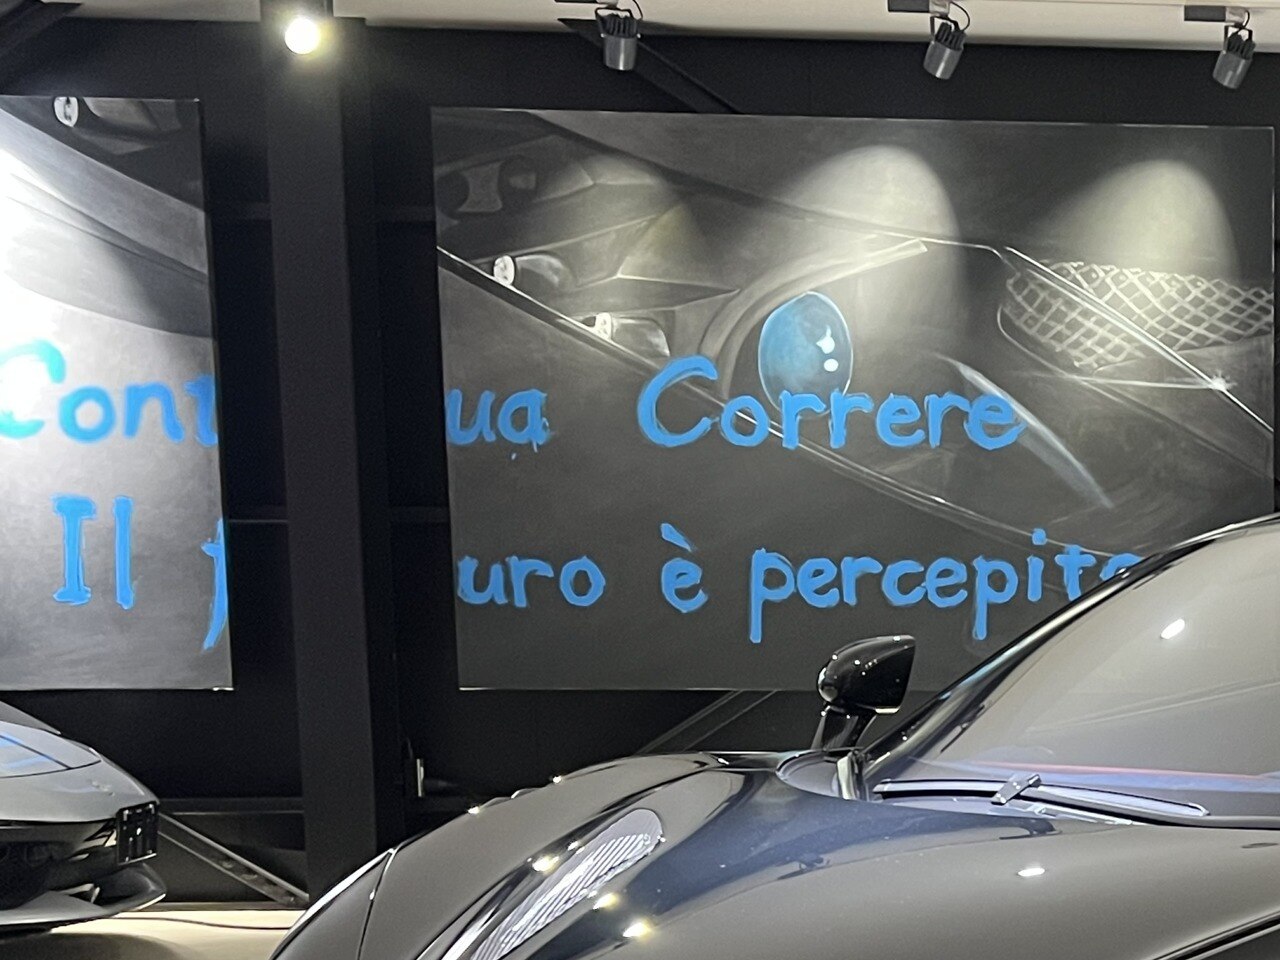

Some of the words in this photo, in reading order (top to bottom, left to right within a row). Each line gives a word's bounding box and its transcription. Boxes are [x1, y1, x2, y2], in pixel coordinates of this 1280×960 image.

[446, 389, 550, 447] ua
[638, 355, 1026, 450] Correre
[53, 495, 134, 609] Il
[457, 555, 606, 608] uro
[661, 523, 708, 613] è
